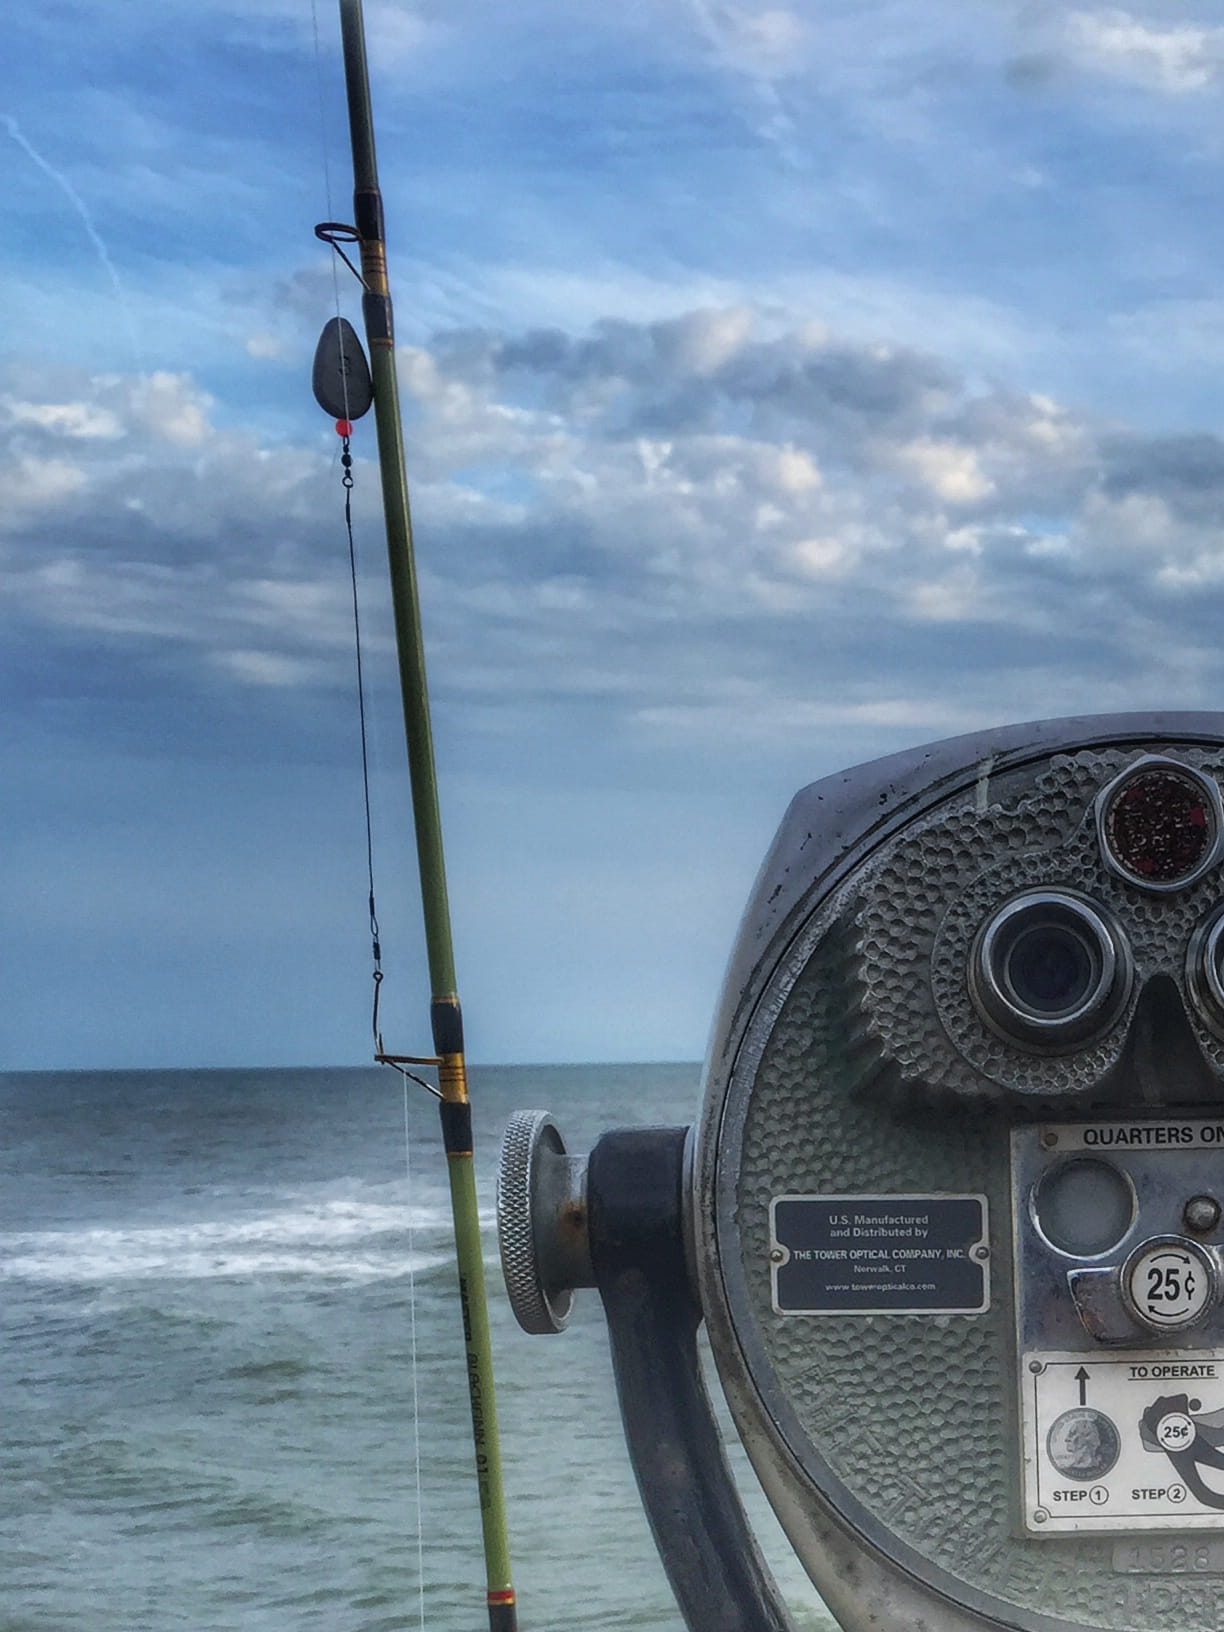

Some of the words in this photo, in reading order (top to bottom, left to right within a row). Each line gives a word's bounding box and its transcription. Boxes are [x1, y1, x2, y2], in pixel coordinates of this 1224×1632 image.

[1084, 1127, 1193, 1145] QUARTERS
[829, 1215, 851, 1225] U.S.
[855, 1215, 928, 1225] Manufactured
[830, 1228, 850, 1237] and
[853, 1227, 912, 1237] Distributed
[915, 1227, 928, 1238] by
[794, 1250, 812, 1260] THE
[814, 1250, 847, 1260] TOWER
[849, 1249, 890, 1259] OPTICAL
[895, 1265, 907, 1273] CT
[1147, 1267, 1195, 1301] 25¢
[1130, 1367, 1149, 1377] TO
[1152, 1365, 1215, 1377] OPERATE
[1164, 1426, 1188, 1439] 25¢
[1053, 1491, 1087, 1502] STEP
[1132, 1488, 1166, 1500] STEP
[1128, 1546, 1209, 1570] 1528
